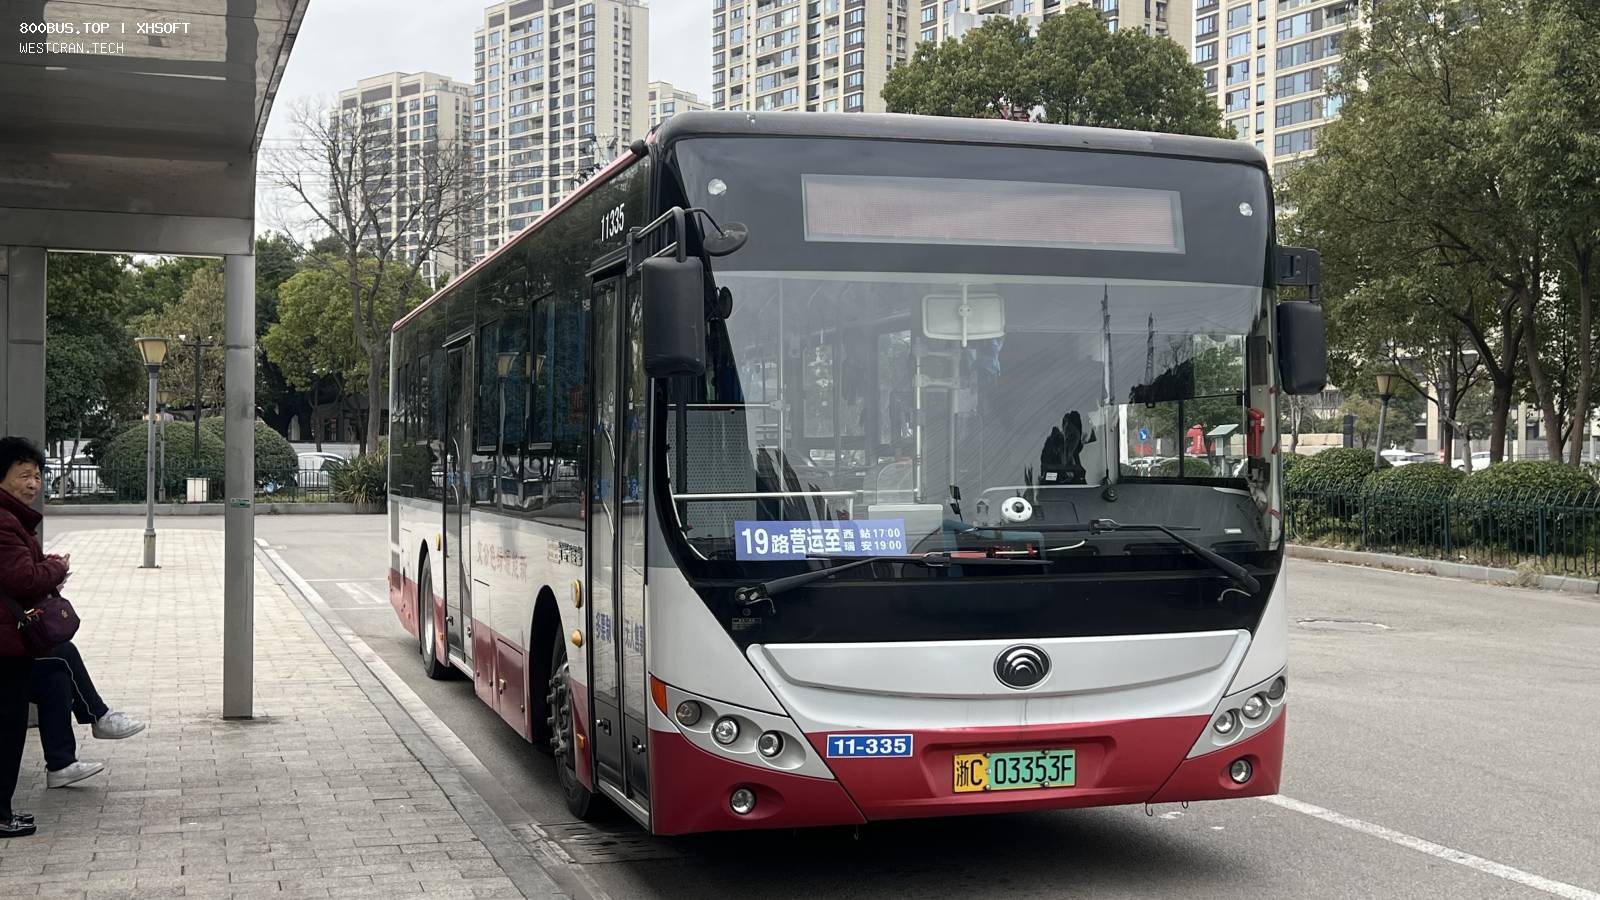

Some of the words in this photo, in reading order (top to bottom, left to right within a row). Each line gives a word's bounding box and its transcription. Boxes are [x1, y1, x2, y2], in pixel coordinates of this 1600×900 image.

[600, 203, 626, 242] 11335
[834, 738, 907, 755] 11-335
[956, 760, 983, 787] 浙C
[994, 755, 1074, 785] 03353F
